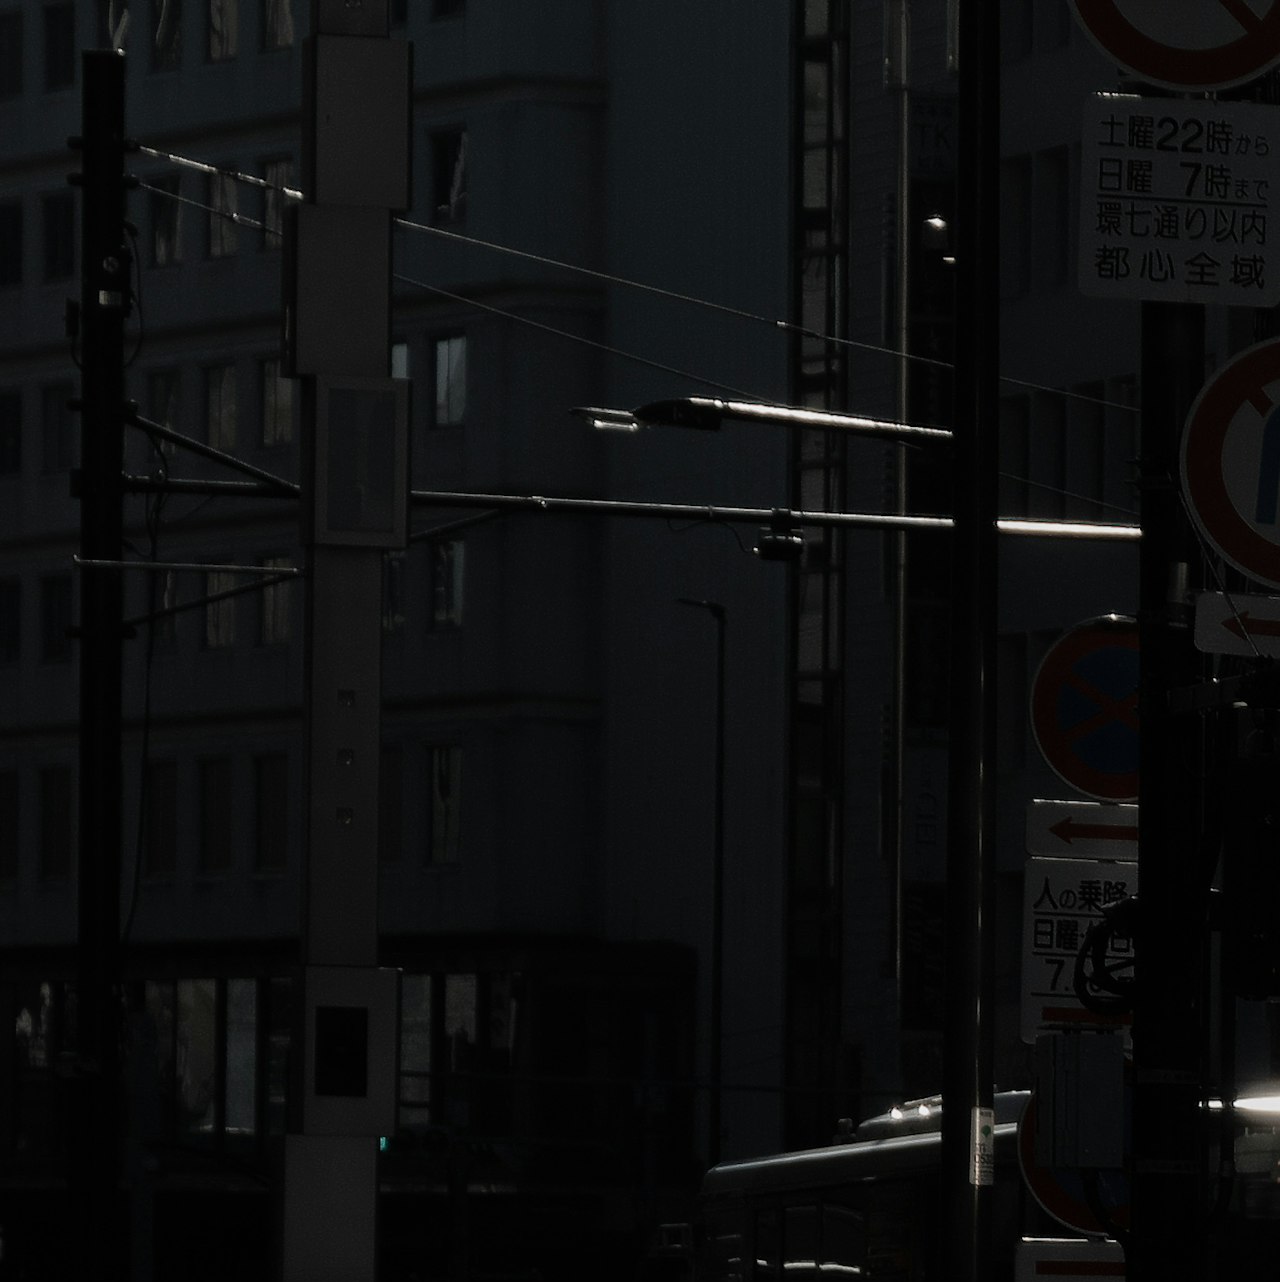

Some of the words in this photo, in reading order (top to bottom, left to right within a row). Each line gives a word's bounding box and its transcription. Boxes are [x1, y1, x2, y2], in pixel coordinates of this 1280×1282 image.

[1098, 114, 1269, 156] 土曜22時から
[1098, 158, 1153, 194] 日曜
[1180, 162, 1269, 201] 7時まで
[1096, 202, 1266, 246] 環七通り以内
[1095, 245, 1265, 289] 都心全域
